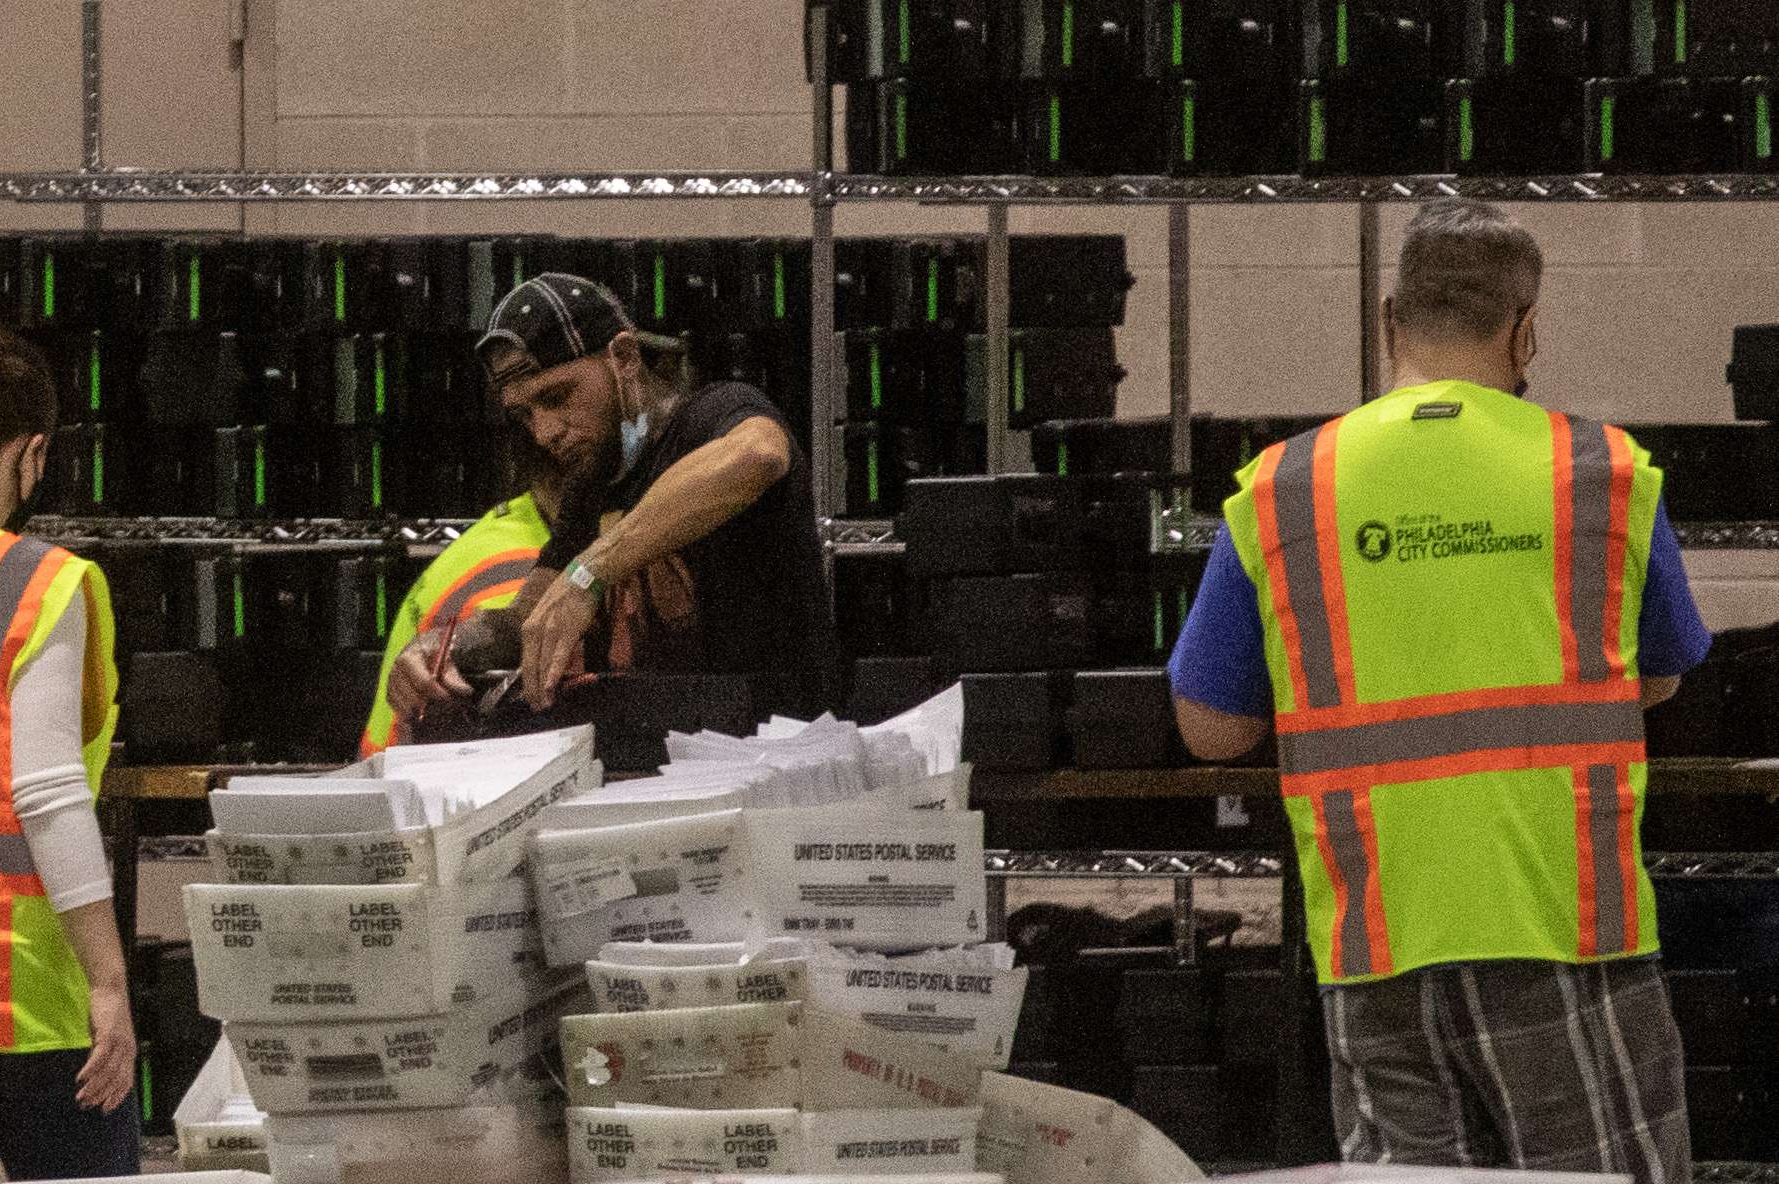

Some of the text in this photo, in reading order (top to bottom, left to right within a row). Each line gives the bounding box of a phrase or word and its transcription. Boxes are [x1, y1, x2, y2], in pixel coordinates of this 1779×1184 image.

[1396, 519, 1493, 544] PHILADELPHIA
[1398, 533, 1544, 563] CITY COMMISSIONERS
[360, 840, 410, 856] LABEL
[794, 843, 956, 861] UNITED STATES POSTAL SERVICE
[211, 903, 259, 917] LABEL
[349, 903, 401, 917] LABEL
[212, 918, 262, 932] OTHER
[349, 918, 402, 932] OTHER
[223, 935, 254, 948] END
[360, 935, 393, 948] END
[737, 974, 780, 989] LABEL
[845, 970, 992, 995] UNITED STATES POSTAL SERVICE
[587, 1122, 633, 1137] LABEL
[724, 1122, 774, 1138] LABEL
[207, 1136, 259, 1150] LABEL
[586, 1138, 635, 1153] OTHER
[724, 1138, 778, 1154] OTHER
[597, 1154, 627, 1169] END
[736, 1155, 769, 1170] END
